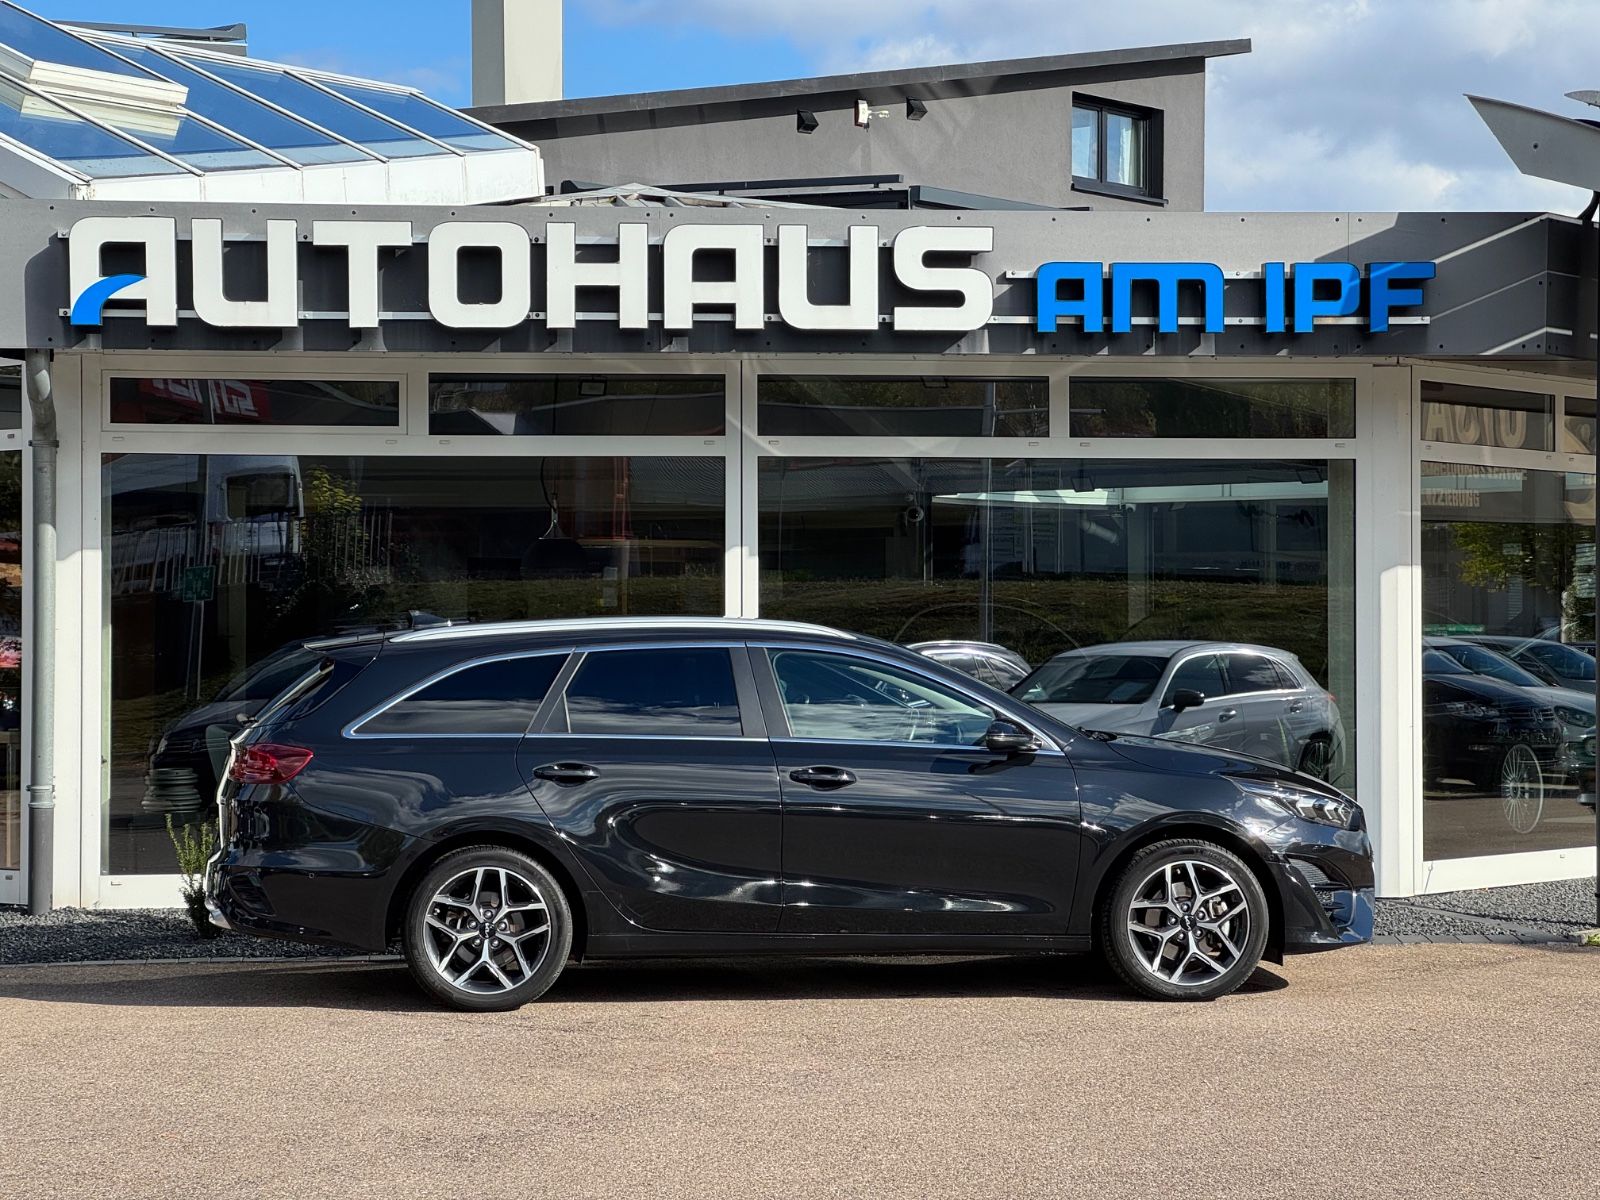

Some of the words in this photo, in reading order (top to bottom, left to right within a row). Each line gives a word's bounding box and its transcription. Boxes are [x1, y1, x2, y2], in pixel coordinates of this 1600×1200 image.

[69, 216, 994, 332] AUTOHAUS
[1036, 261, 1225, 334] AM
[1265, 261, 1437, 334] IPF
